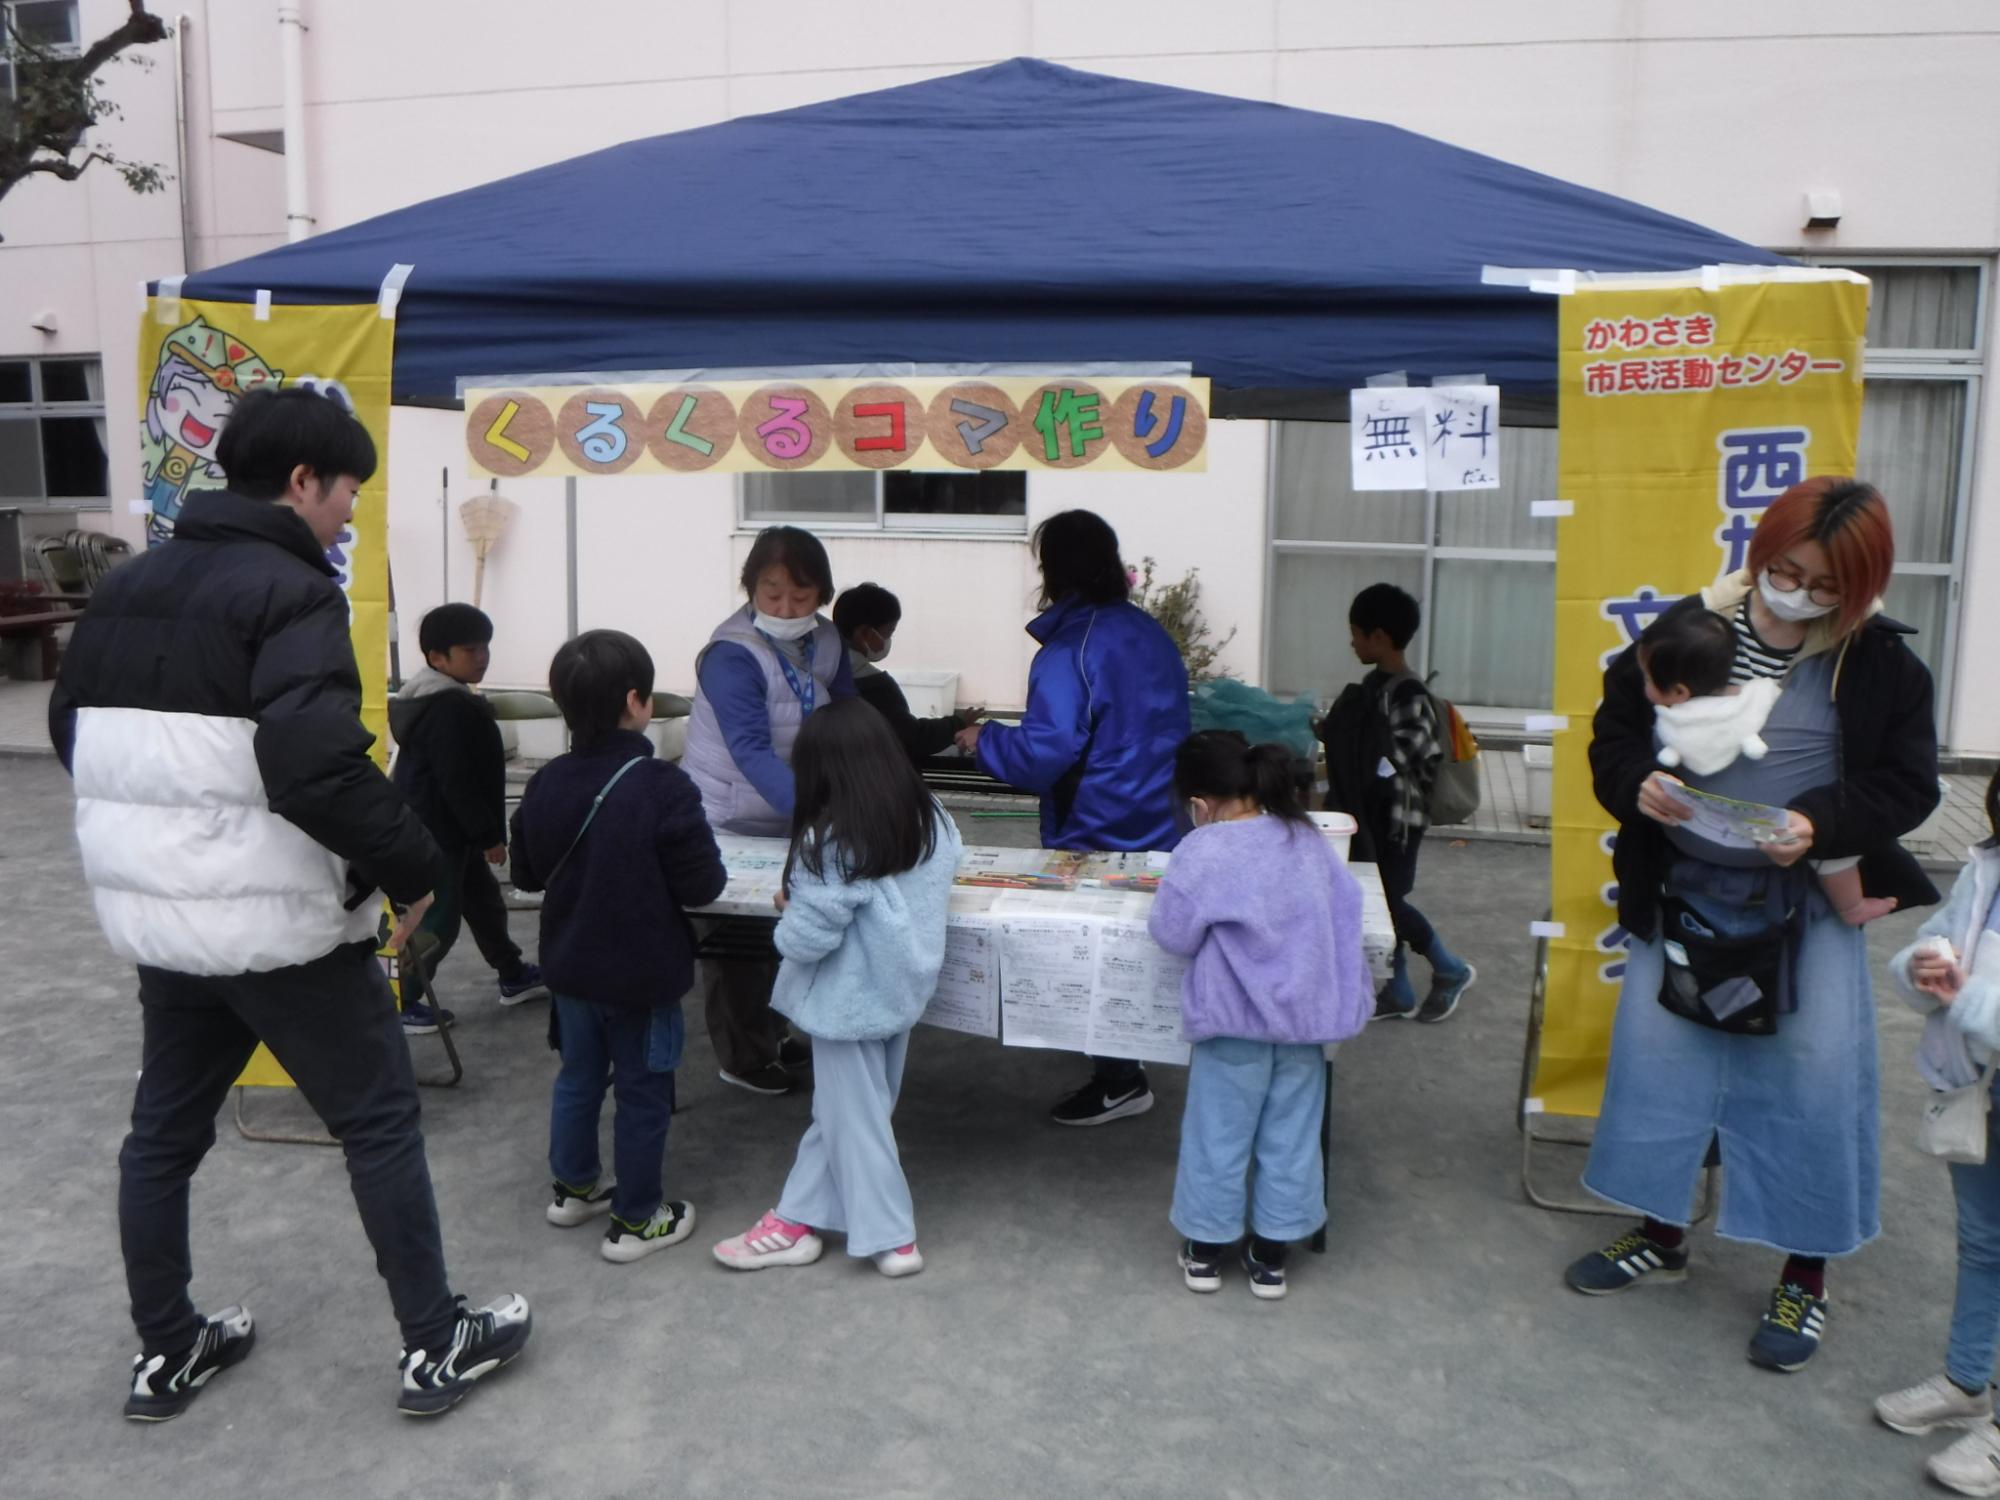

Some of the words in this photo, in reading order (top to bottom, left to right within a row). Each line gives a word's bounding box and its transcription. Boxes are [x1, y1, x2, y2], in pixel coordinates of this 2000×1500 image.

[1586, 315, 1714, 351] かわさき
[1585, 351, 1842, 394] 市民活動センター
[484, 388, 1187, 464] くるくるコマ作り
[1361, 404, 1492, 461] 無料
